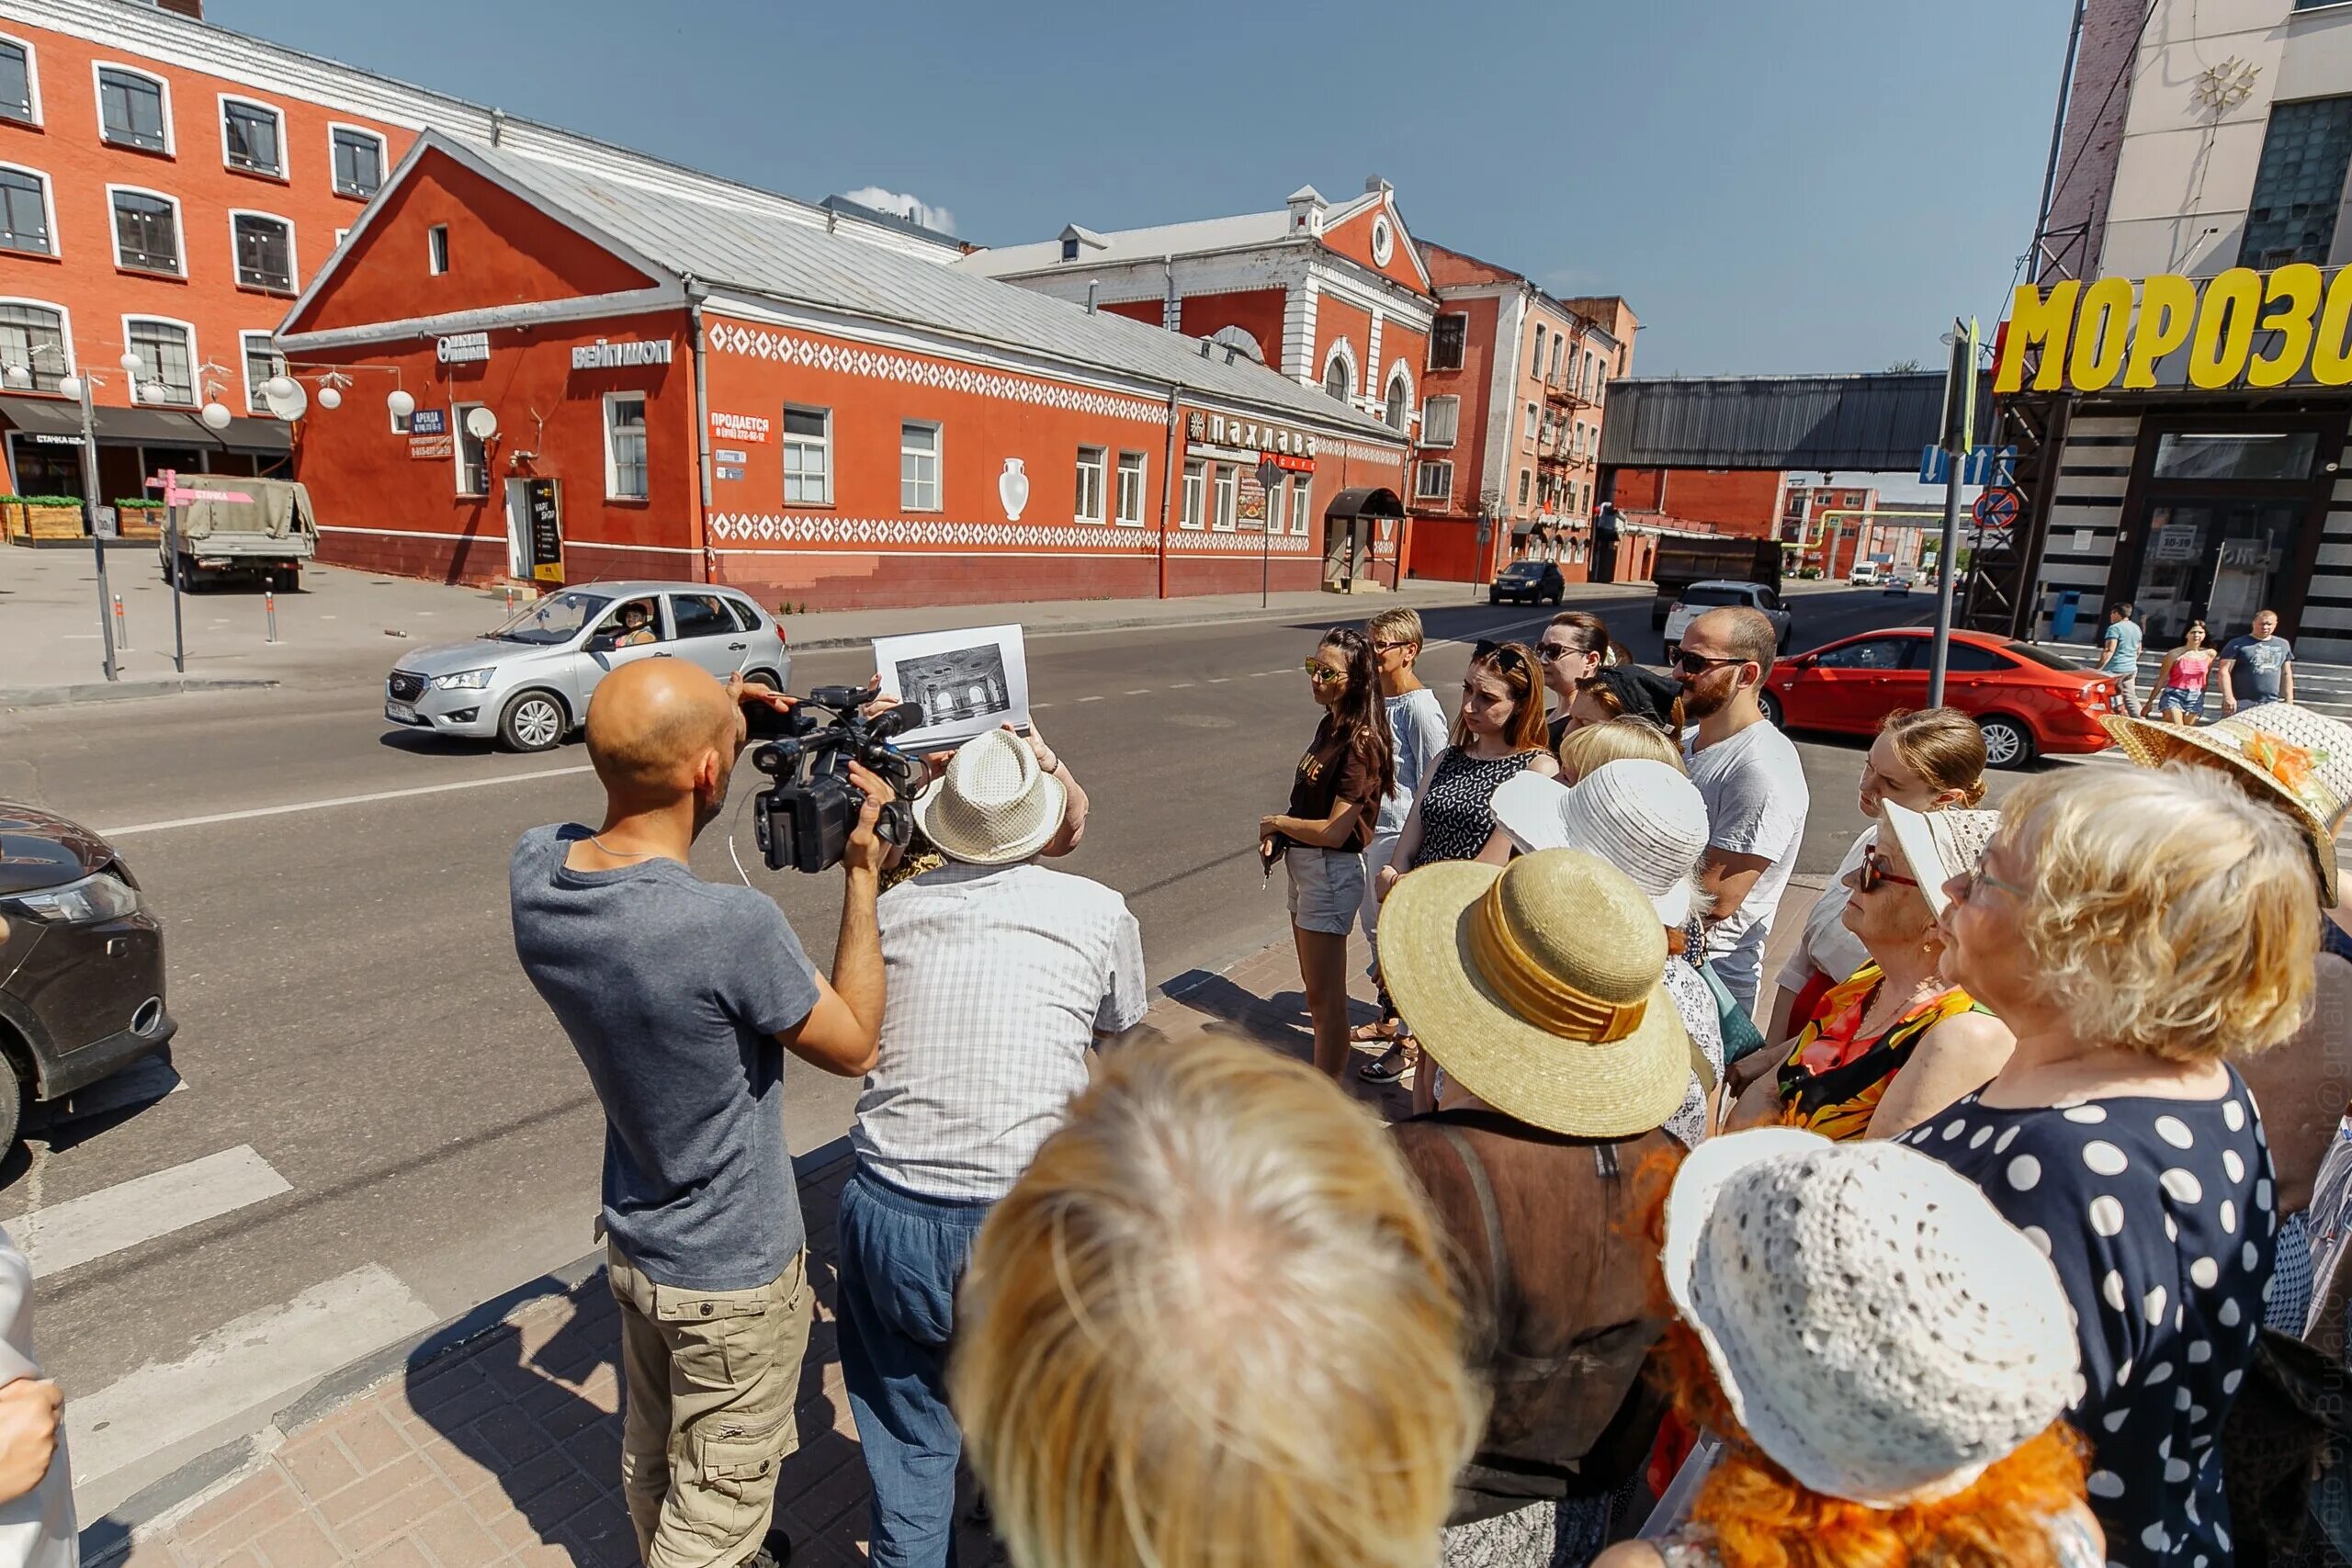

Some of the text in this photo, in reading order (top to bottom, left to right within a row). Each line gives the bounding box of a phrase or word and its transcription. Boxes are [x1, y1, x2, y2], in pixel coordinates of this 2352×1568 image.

[572, 339, 673, 369] ВЕЙП ШОП
[416, 412, 438, 423] АРЕНДА
[711, 412, 770, 433] ПРОДАЕТСЯ
[37, 434, 68, 445] СТАЧКА
[195, 490, 229, 501] СТАЧКА
[535, 502, 548, 512] VAPE
[541, 510, 555, 520] SHOP
